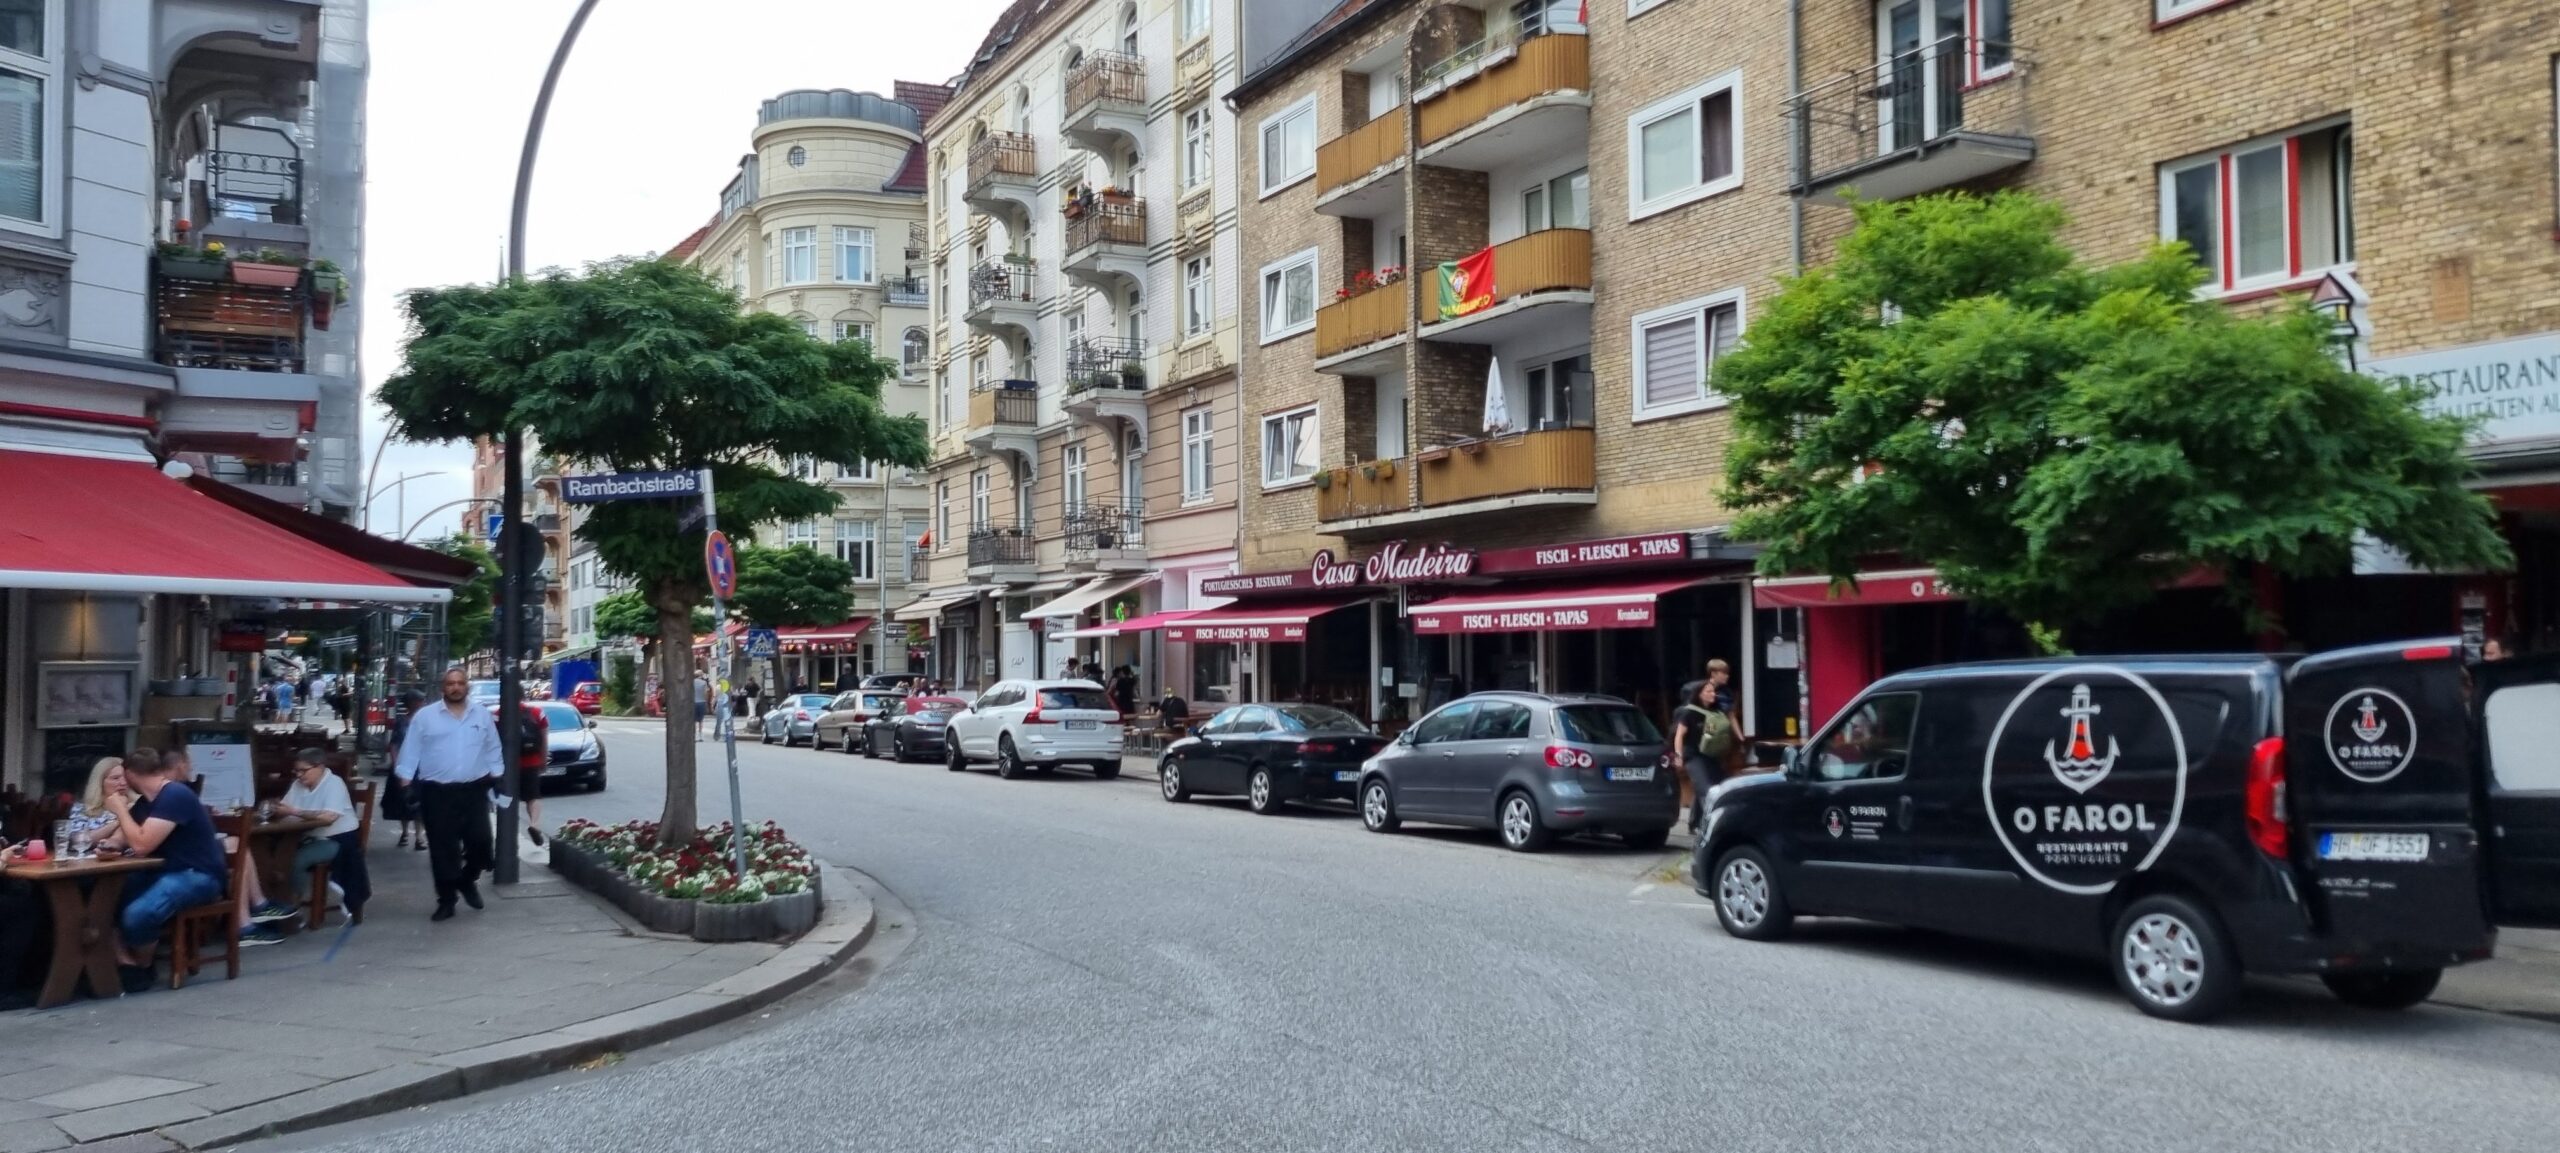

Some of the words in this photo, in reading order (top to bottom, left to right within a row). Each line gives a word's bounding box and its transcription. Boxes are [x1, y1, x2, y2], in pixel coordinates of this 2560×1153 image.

[568, 474, 695, 497] Rambachstraße
[1536, 549, 1568, 564] FISCH
[1579, 543, 1630, 561] FLEISCH
[1640, 539, 1680, 555] TAPAS
[1312, 551, 1358, 586] Casa
[1365, 543, 1472, 581] Madeira
[1204, 578, 1253, 592] PORTUGIESISCHES
[1255, 575, 1292, 588] RESTAURANT
[1463, 615, 1492, 628] FISCH
[1500, 612, 1545, 628] FLEISCH
[1553, 610, 1588, 625] TAPAS
[1196, 627, 1213, 639] FISCH
[1218, 627, 1244, 639] FLEISCH
[1249, 627, 1269, 638] TAPAS
[2013, 806, 2037, 834] O
[2044, 803, 2155, 832] FAROL
